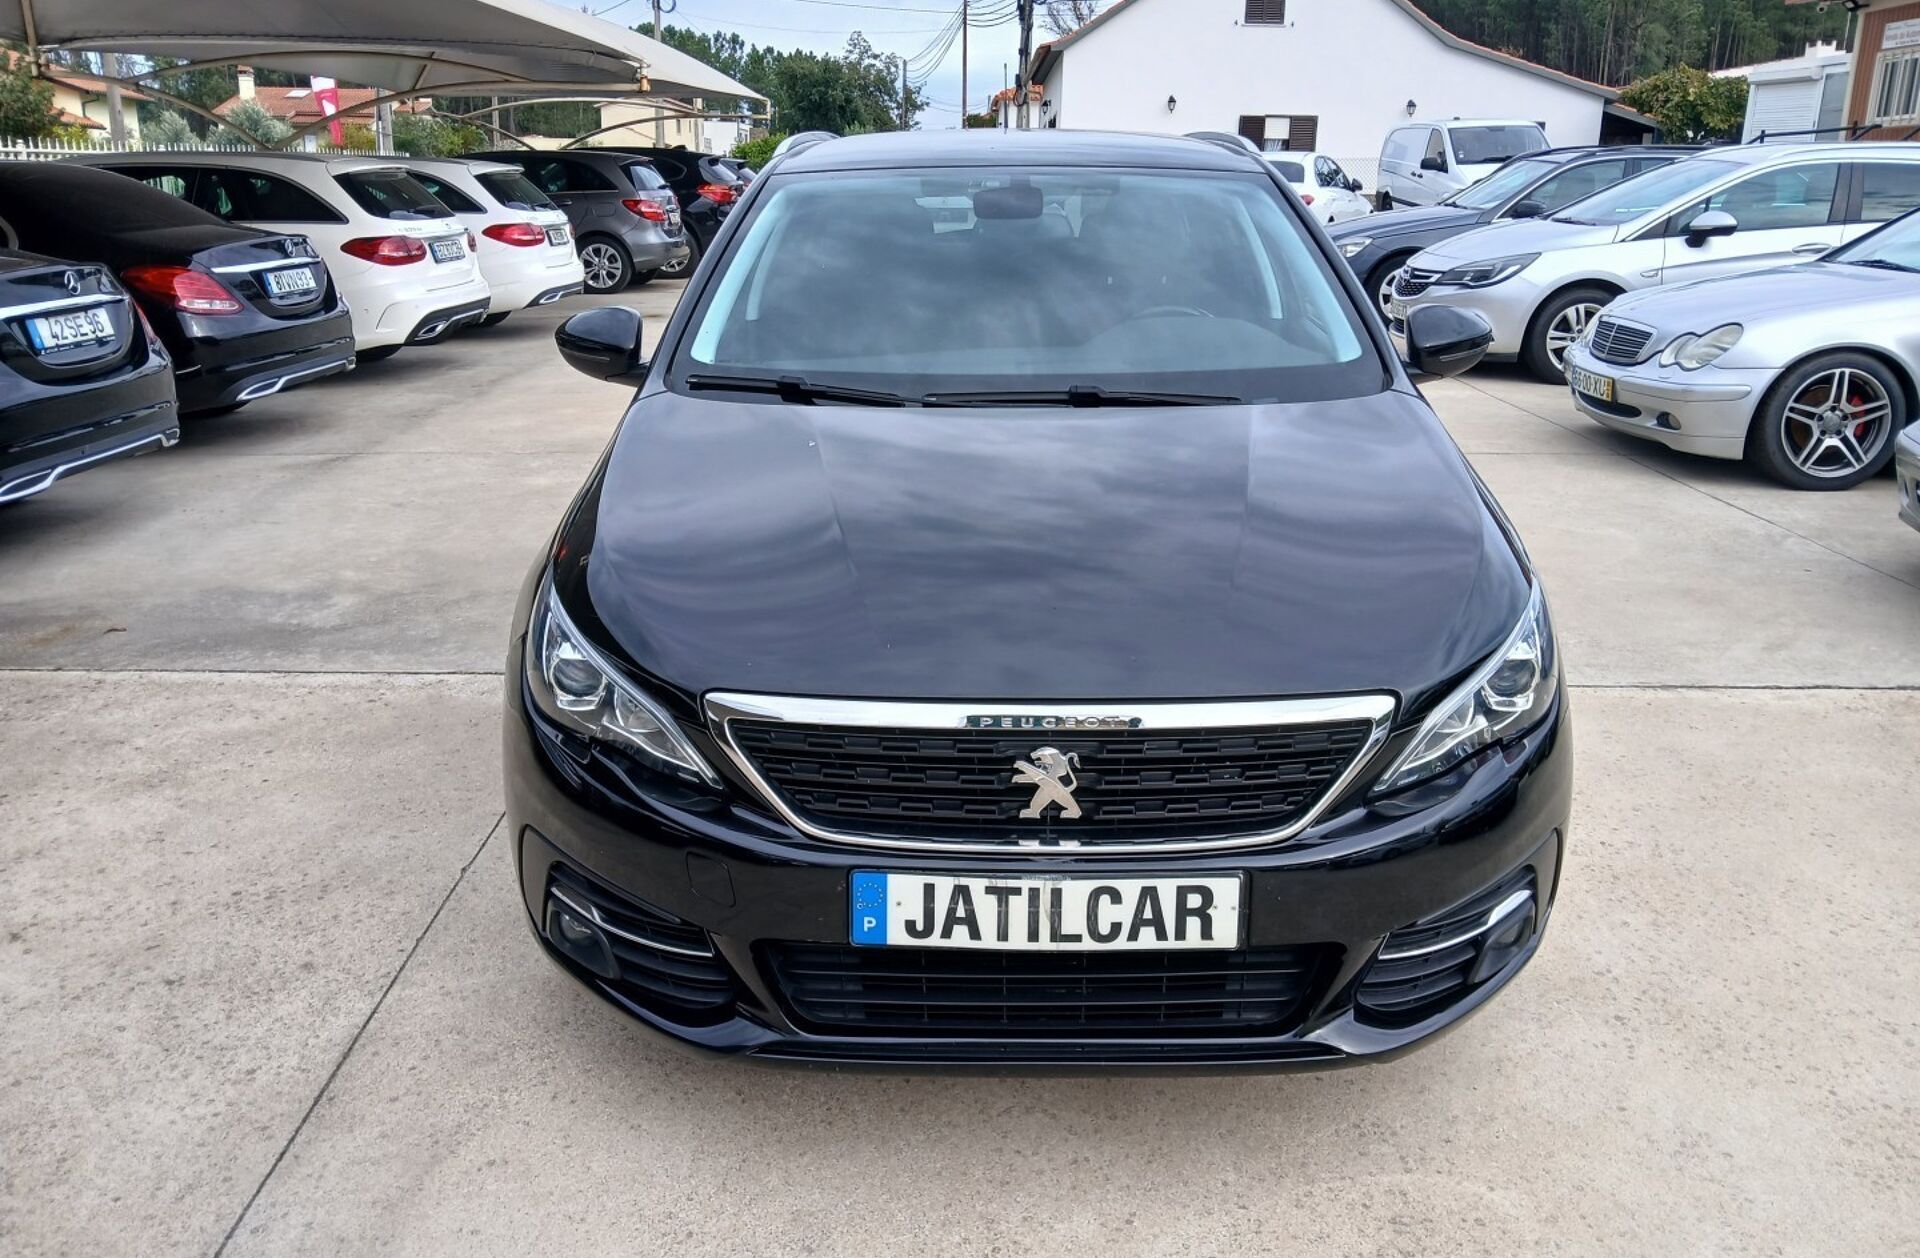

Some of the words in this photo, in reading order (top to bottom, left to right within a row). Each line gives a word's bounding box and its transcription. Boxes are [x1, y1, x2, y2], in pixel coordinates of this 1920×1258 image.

[979, 716, 1120, 728] PEUGEOT
[904, 882, 1216, 944] JATILCAR
[863, 916, 877, 932] P
